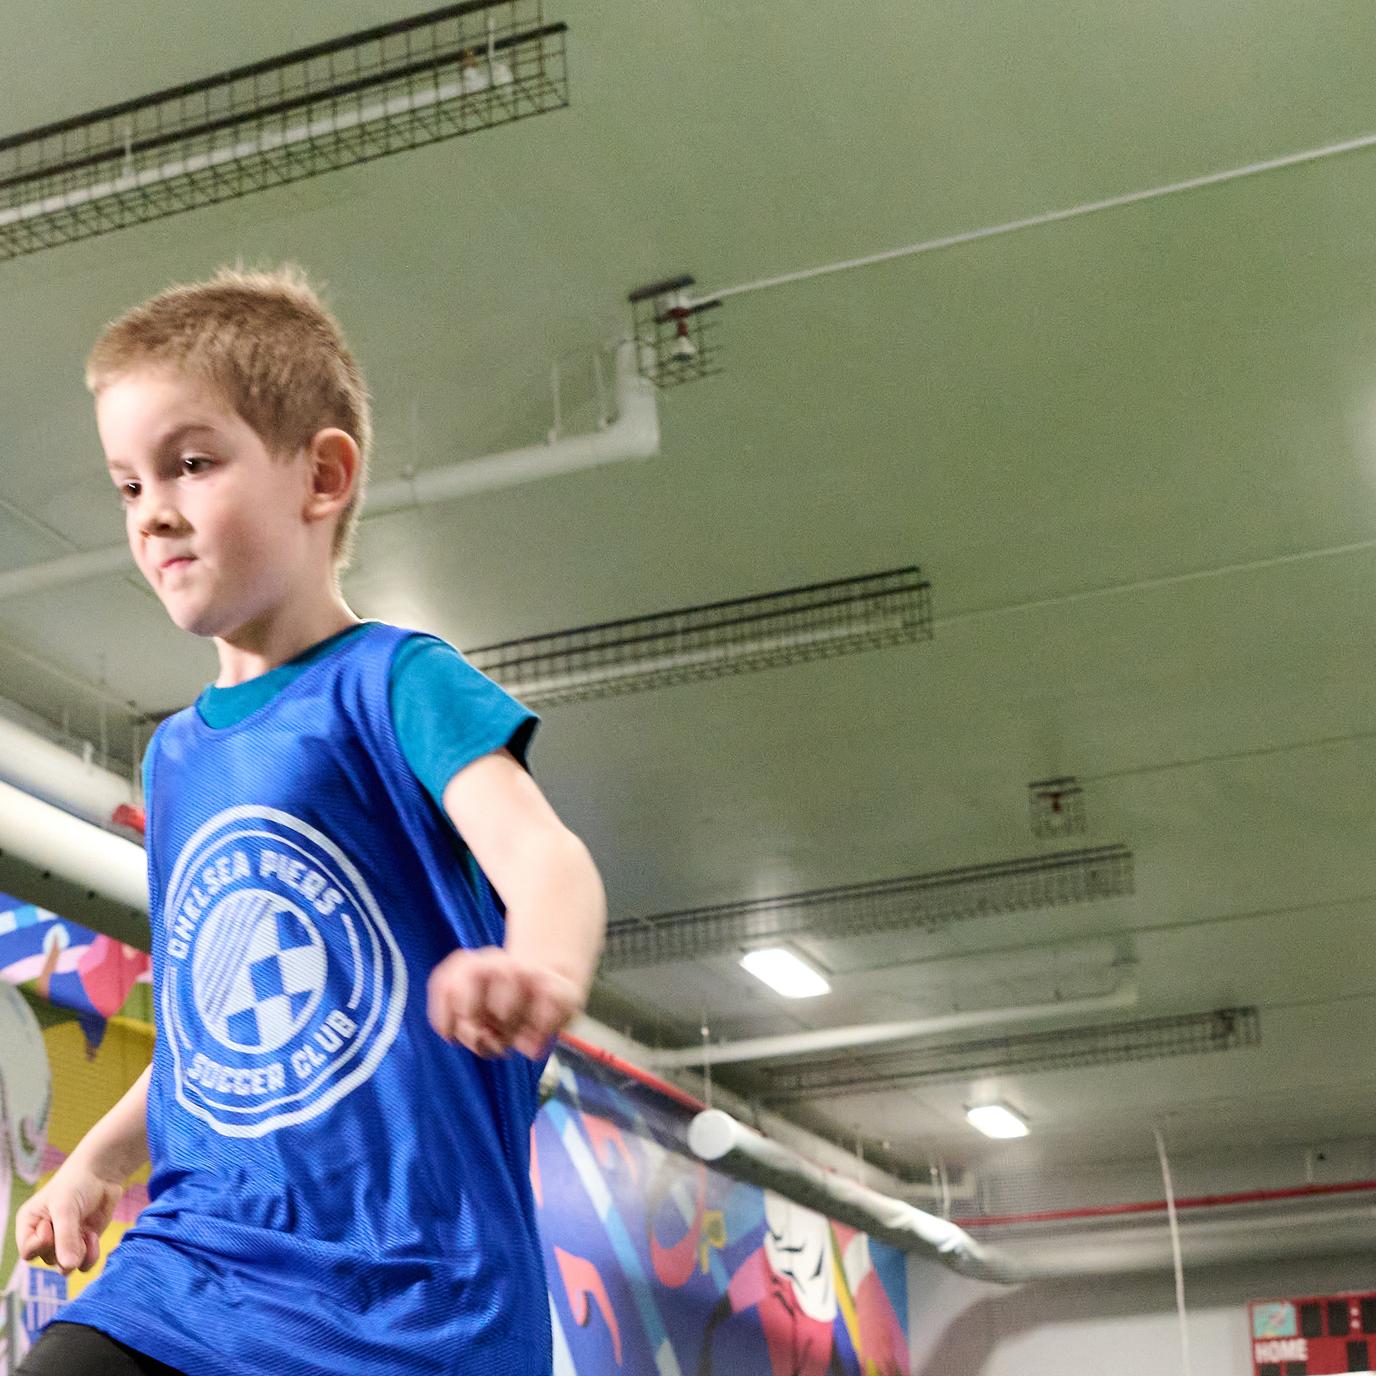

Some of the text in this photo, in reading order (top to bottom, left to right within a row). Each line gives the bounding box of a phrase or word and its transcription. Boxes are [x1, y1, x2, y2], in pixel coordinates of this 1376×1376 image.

[167, 849, 346, 960] CHELSEA PIERS
[187, 1007, 358, 1096] SOCCER CLUB
[1255, 1338, 1308, 1363] HOME
